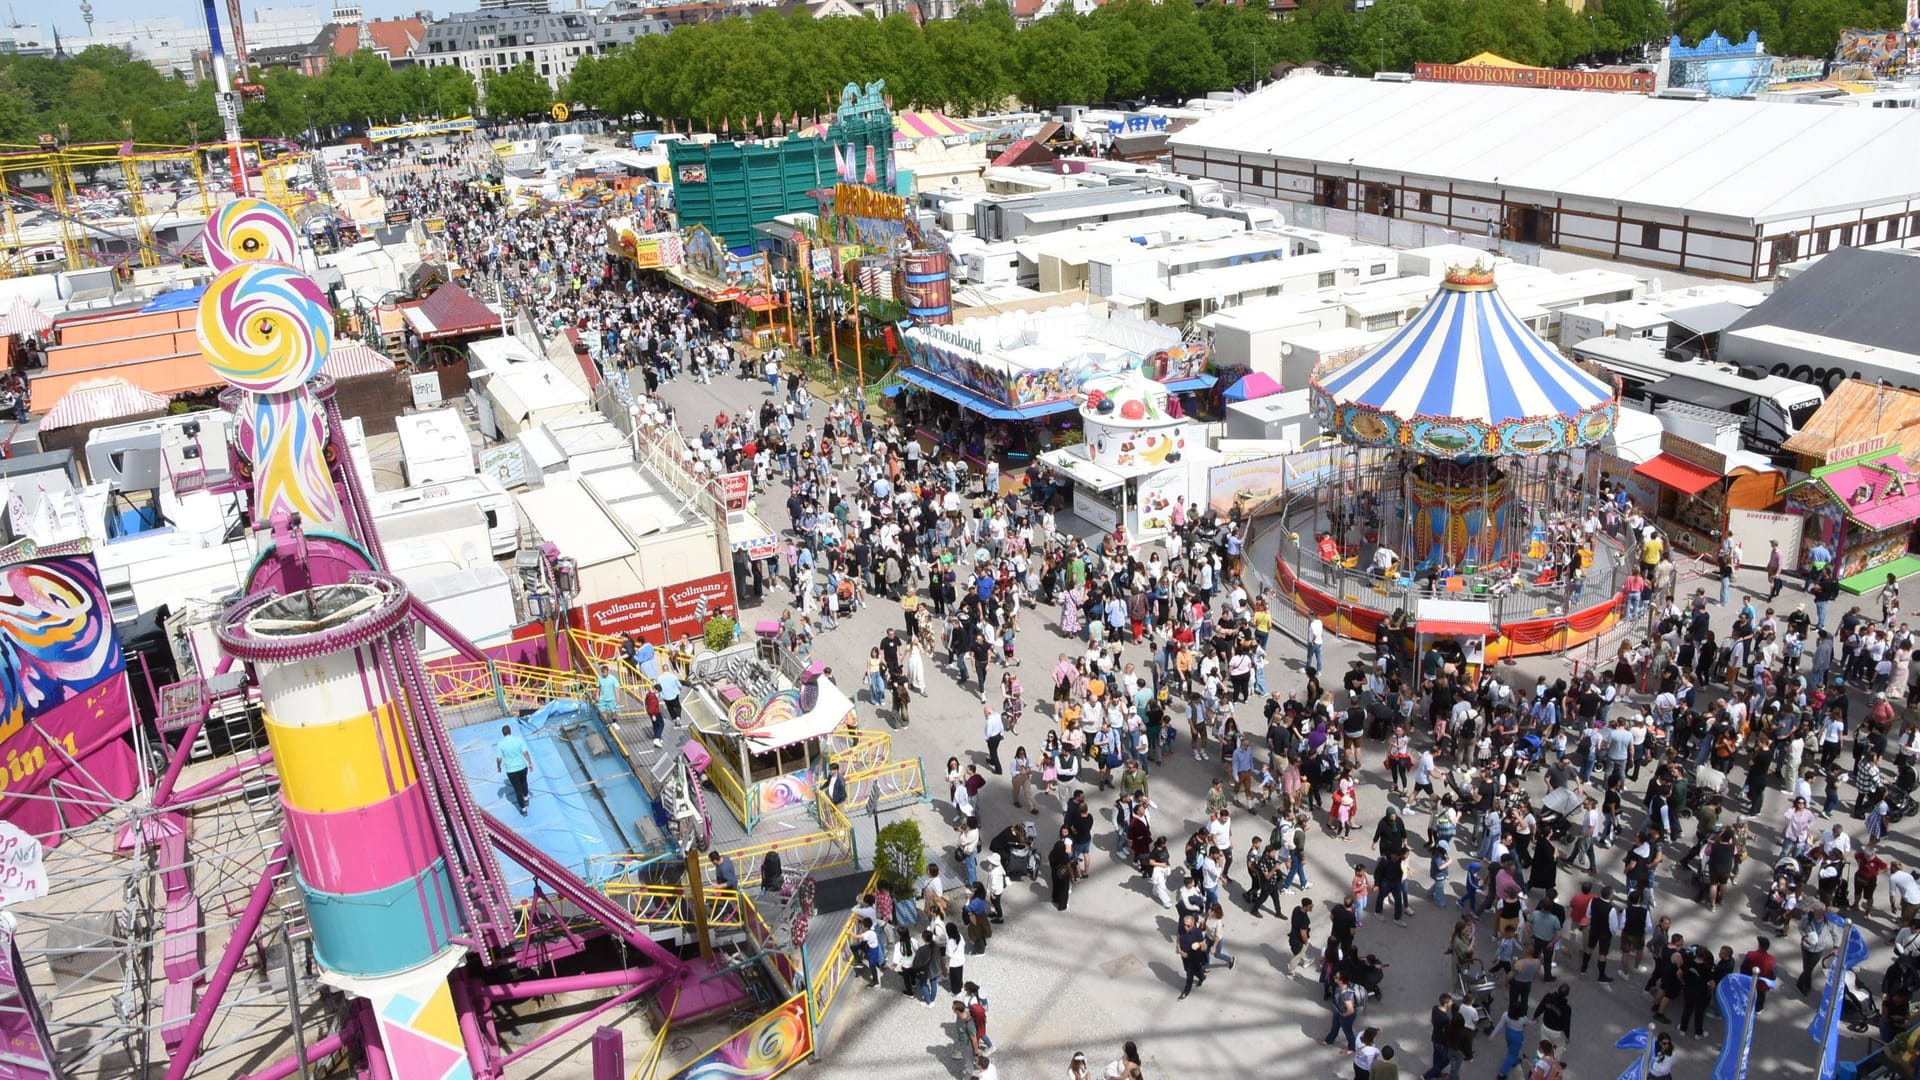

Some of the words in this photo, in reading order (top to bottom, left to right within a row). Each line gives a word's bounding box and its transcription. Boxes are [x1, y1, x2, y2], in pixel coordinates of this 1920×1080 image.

[1433, 65, 1515, 82] HIPPODROM
[1536, 70, 1631, 89] HIPPODROM
[639, 252, 658, 262] PIZZA
[919, 320, 983, 356] Sternenland
[1622, 397, 1643, 407] UTBACK
[1792, 398, 1820, 411] OUTBACK
[1829, 443, 1856, 461] SÜSSE
[1858, 435, 1885, 454] HÜTTE
[706, 591, 726, 600] ompany
[629, 609, 653, 619] Company
